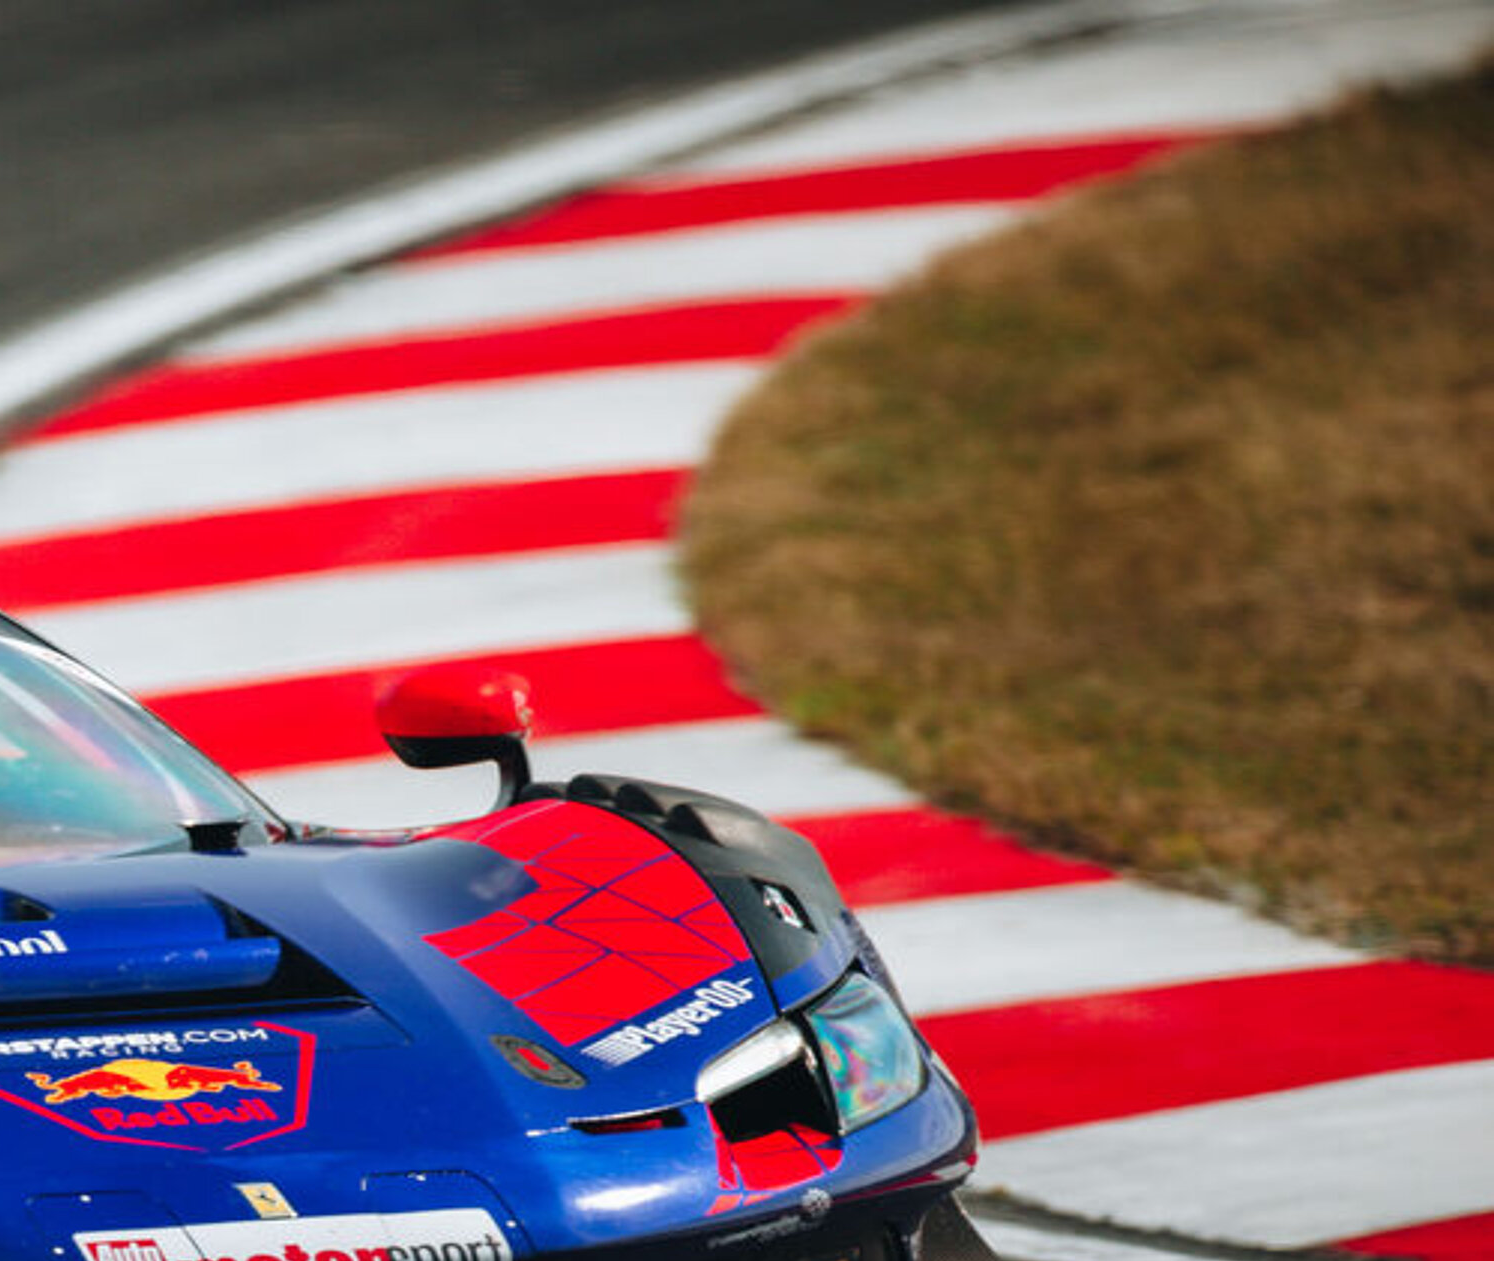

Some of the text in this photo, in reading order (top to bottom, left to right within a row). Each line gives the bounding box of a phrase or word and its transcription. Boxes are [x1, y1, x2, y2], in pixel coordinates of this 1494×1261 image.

[51, 1043, 184, 1060] RACING
[90, 1098, 278, 1130] Red Bull
